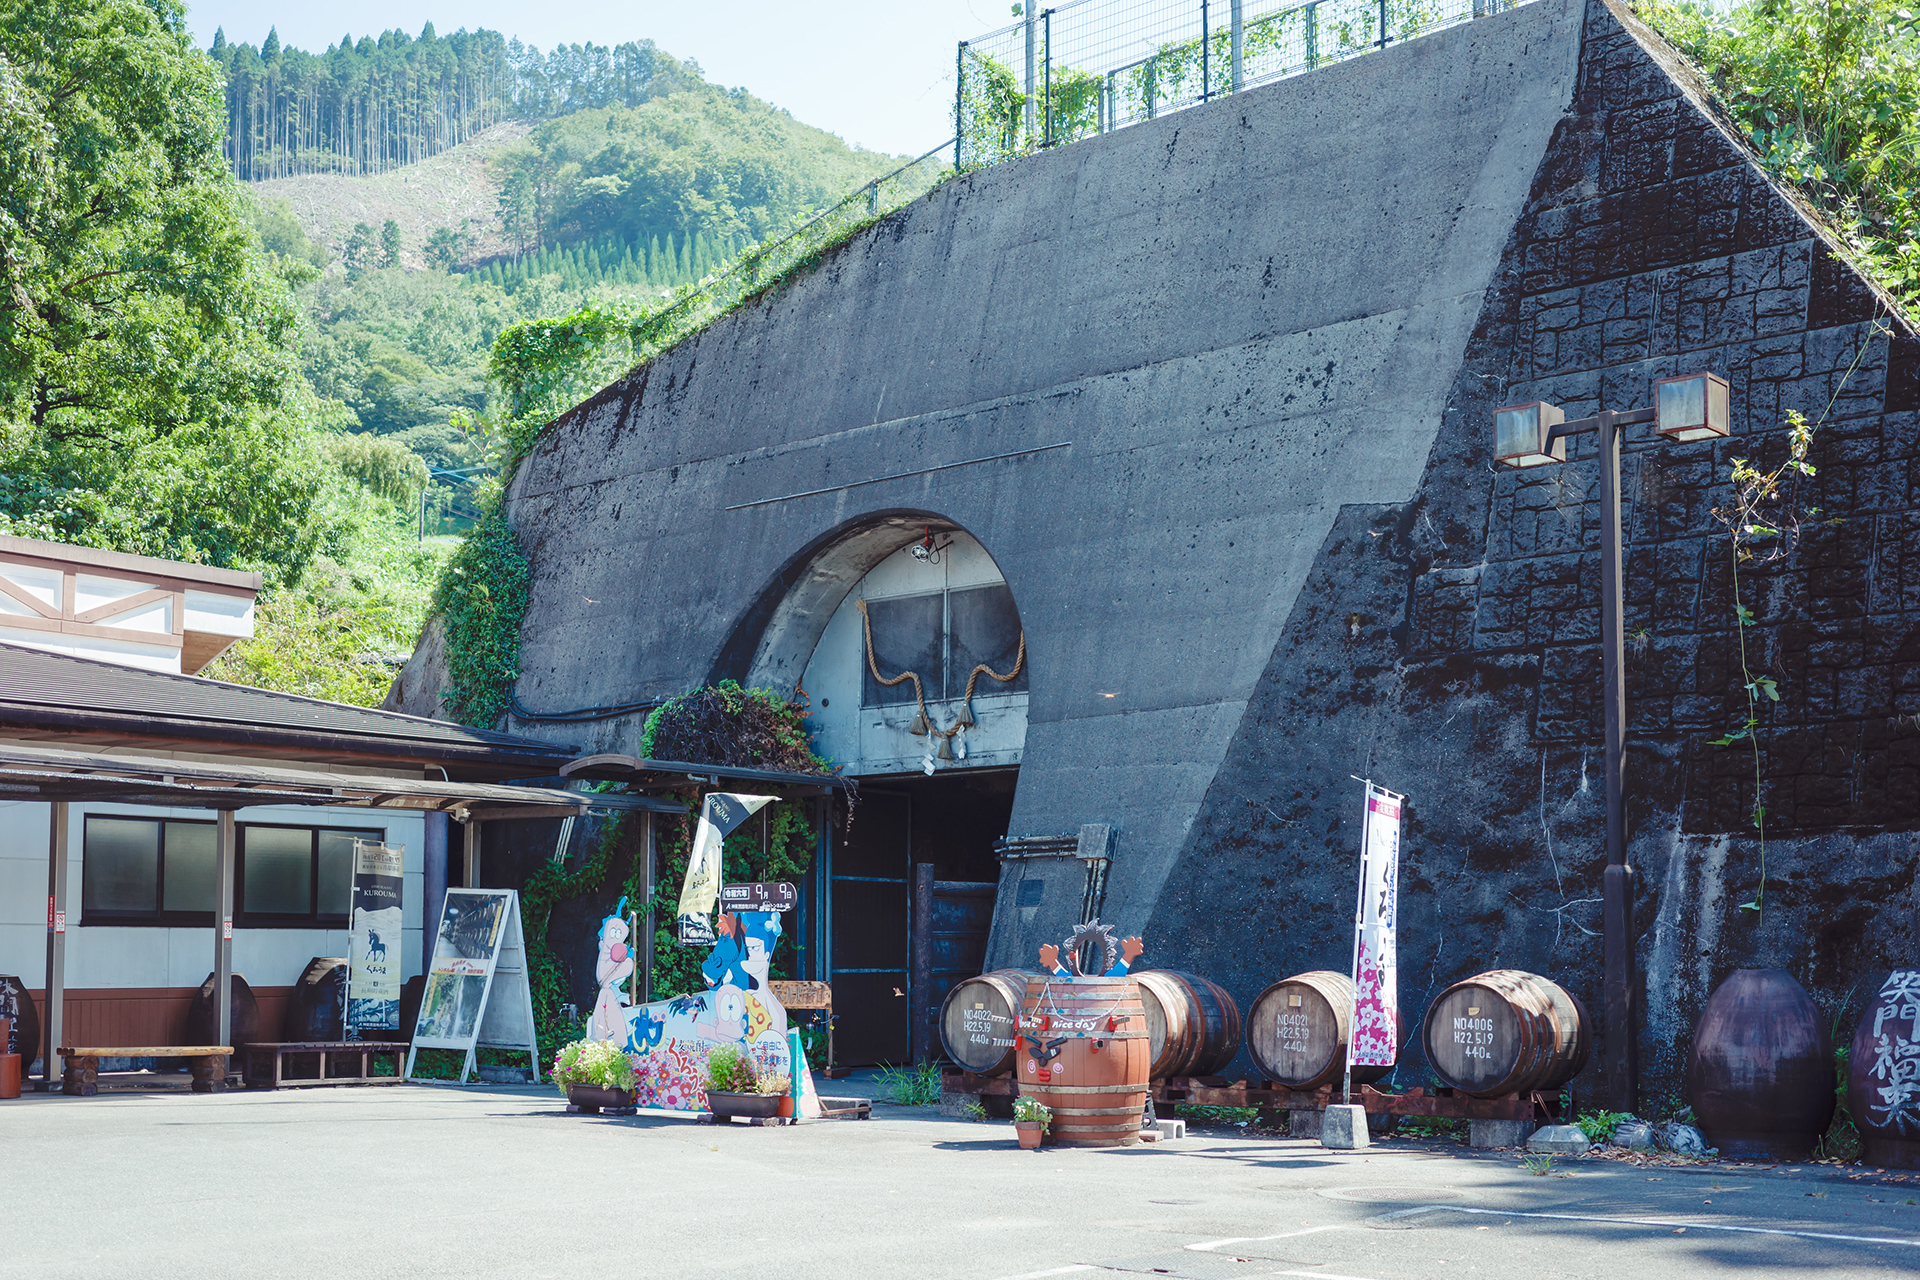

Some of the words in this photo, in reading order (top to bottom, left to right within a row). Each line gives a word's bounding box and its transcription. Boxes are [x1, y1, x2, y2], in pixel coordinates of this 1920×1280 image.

[363, 890, 397, 899] KUROUMA
[1052, 1020, 1074, 1029] nice
[1075, 1018, 1097, 1031] day
